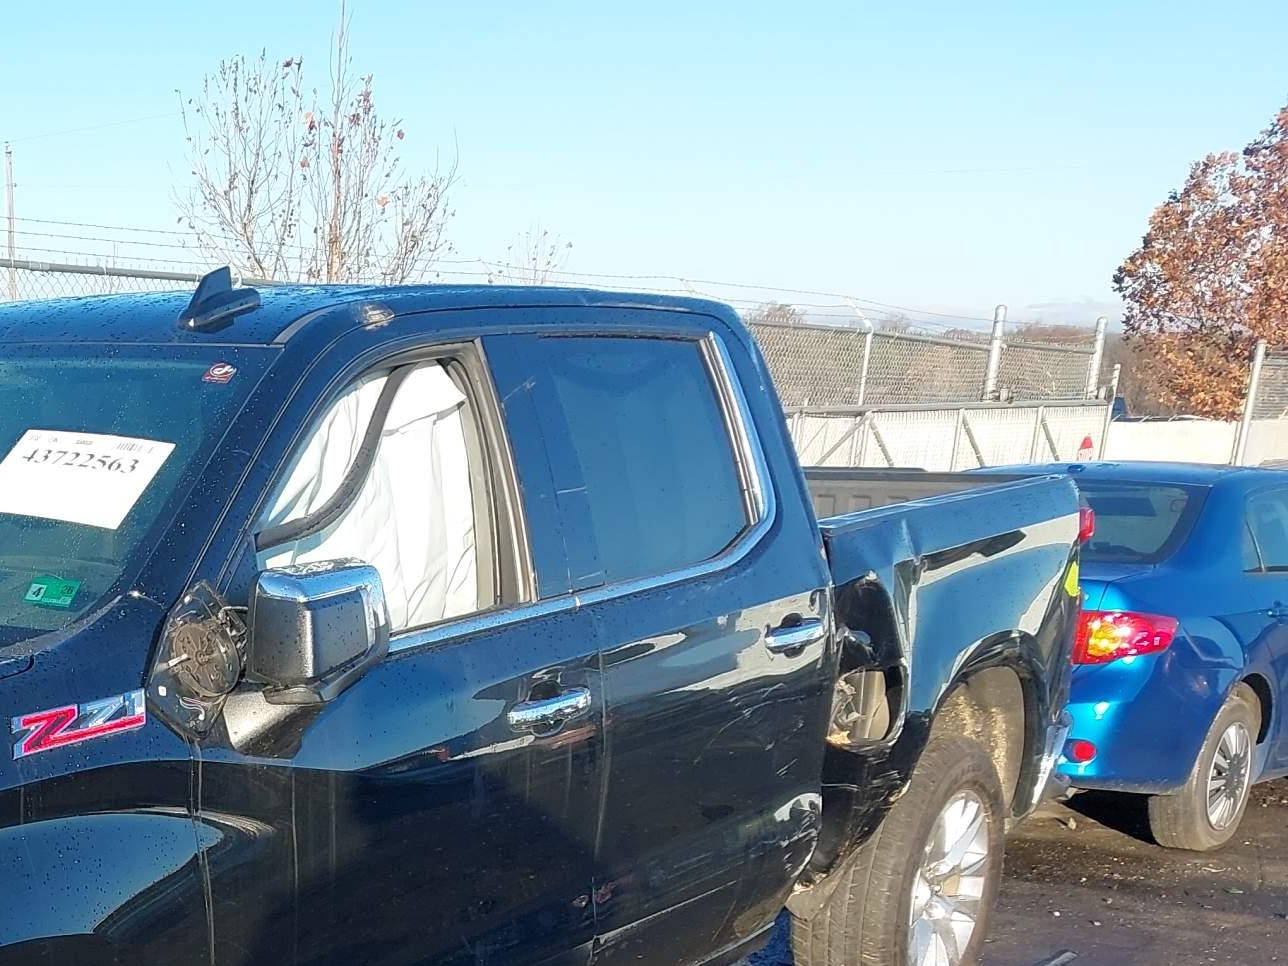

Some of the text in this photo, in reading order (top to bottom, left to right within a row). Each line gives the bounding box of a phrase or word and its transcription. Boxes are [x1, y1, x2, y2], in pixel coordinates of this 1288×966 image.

[22, 448, 139, 473] 43722563
[32, 586, 44, 597] 4
[12, 688, 146, 760] Z71
